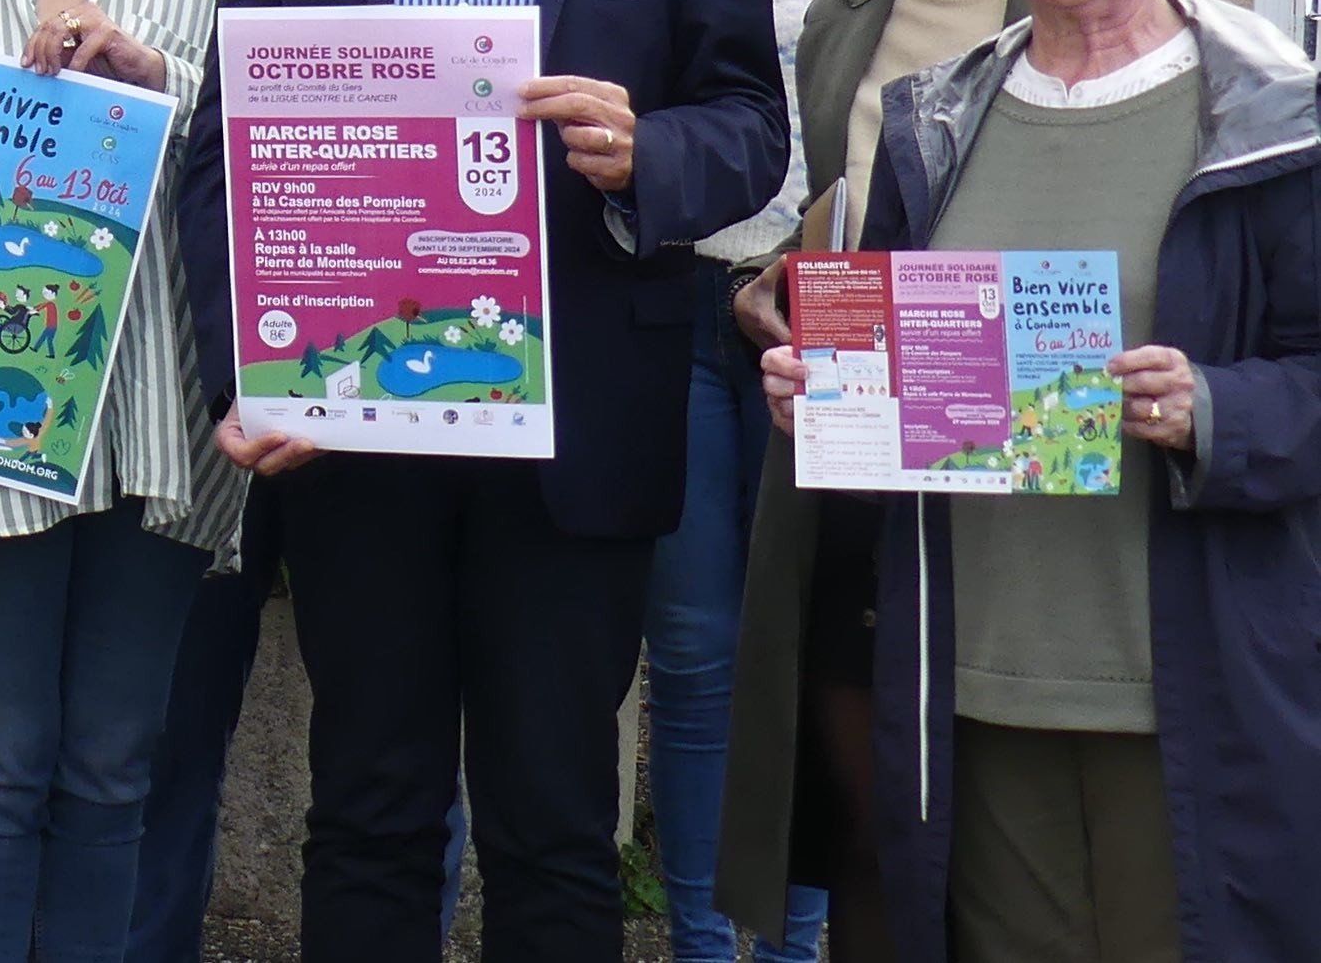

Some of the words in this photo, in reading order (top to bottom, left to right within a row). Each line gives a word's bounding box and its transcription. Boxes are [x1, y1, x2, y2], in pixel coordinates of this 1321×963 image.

[247, 44, 331, 59] JOURNÉE
[338, 47, 434, 59] SOLIDAIRE
[249, 63, 363, 79] OCTOBRE
[371, 63, 436, 79] ROSE
[271, 94, 299, 103] LIGUE
[301, 94, 340, 103] CONTRE
[343, 94, 355, 103] LE
[357, 94, 397, 103] CANCER
[464, 101, 503, 112] CCAS
[249, 125, 337, 141] MARCHE
[343, 125, 399, 141] ROSE
[251, 143, 438, 160] INTER-QUARTIERS
[463, 131, 511, 164] 13
[251, 162, 277, 171] suivie
[280, 161, 300, 171] d'un
[302, 163, 329, 173] repas
[331, 162, 356, 171] offert
[15, 155, 36, 187] 6
[35, 174, 58, 189] au
[57, 169, 92, 200] 13
[466, 169, 511, 184] OCT
[252, 182, 281, 194] RDV
[284, 182, 315, 194] 9h00
[474, 188, 501, 197] 2024
[92, 202, 121, 217] 2024
[252, 195, 261, 207] à
[263, 196, 275, 207] la
[279, 196, 333, 208] Caserne
[336, 196, 359, 207] des
[363, 196, 426, 210] Pompiers
[254, 227, 265, 241] À
[268, 229, 307, 241] 13h00
[255, 243, 295, 257] Repas
[299, 243, 307, 255] à
[311, 243, 323, 255] la
[325, 243, 356, 255] salle
[413, 245, 435, 253] AVANT
[437, 245, 447, 253] LE
[255, 257, 294, 269] Pierre
[297, 257, 313, 269] de
[317, 257, 401, 271] Montesquiou
[797, 261, 851, 269] SOLIDARITÉ
[897, 263, 944, 272] JOURNÉE
[947, 263, 997, 272] SOLIDAIRE
[899, 273, 960, 283] OCTOBRE
[965, 273, 999, 283] ROSE
[1013, 276, 1051, 295] Bien
[1058, 278, 1108, 295] vivre
[981, 287, 997, 301] 13
[257, 295, 289, 307] Droit
[293, 295, 373, 309] d'inscription
[1013, 299, 1111, 316] ensemble
[899, 310, 939, 319] MARCHE
[941, 310, 965, 319] ROSE
[263, 319, 293, 329] Adulte
[899, 320, 983, 329] INTER-QUARTIERS
[1026, 317, 1071, 330] Condom
[269, 329, 286, 341] 8€
